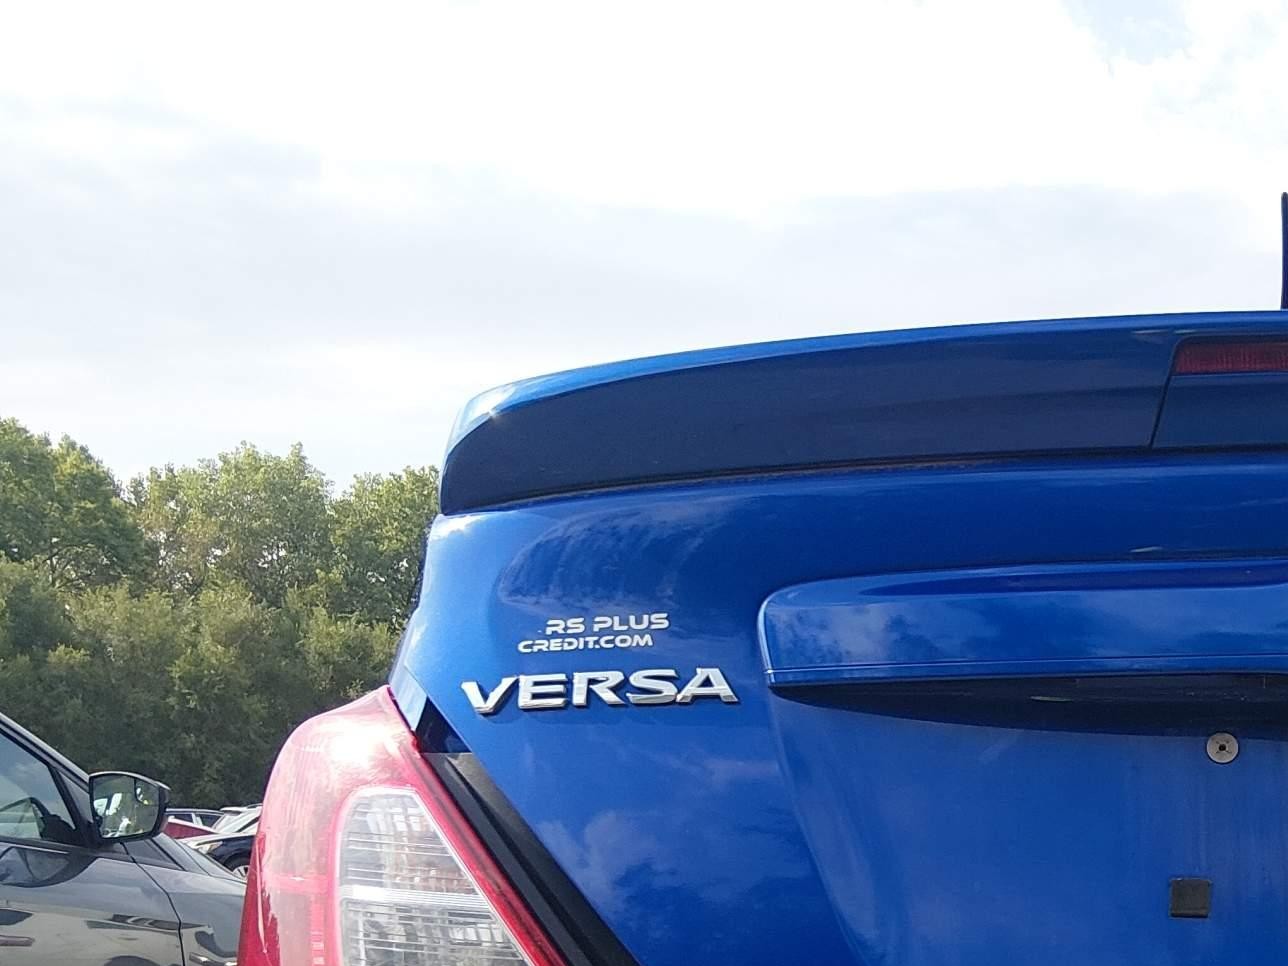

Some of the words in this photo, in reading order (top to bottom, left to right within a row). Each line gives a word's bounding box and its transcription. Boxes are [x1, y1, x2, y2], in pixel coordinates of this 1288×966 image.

[545, 617, 585, 635] RS
[592, 613, 669, 632] PLUS
[517, 634, 653, 653] CREDIT.COM
[461, 667, 739, 714] VERSA
